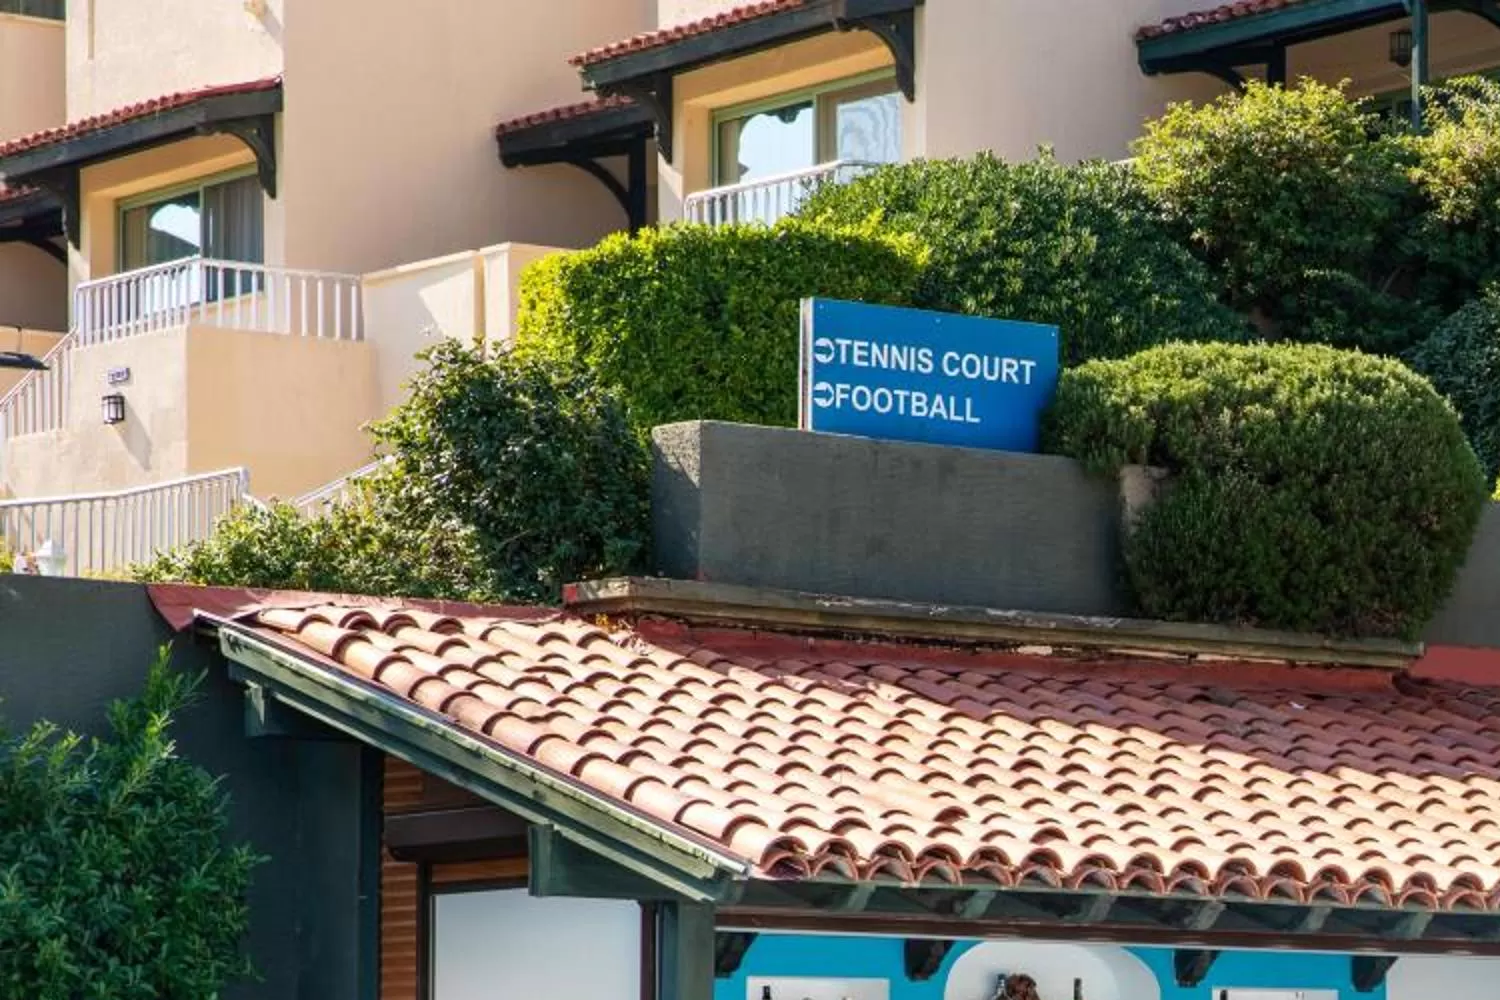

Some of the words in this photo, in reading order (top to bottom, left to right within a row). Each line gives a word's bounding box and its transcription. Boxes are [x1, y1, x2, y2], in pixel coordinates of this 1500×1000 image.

[835, 338, 934, 374] TENNIS
[942, 351, 1036, 385] COURT
[835, 383, 981, 423] FOOTBALL
